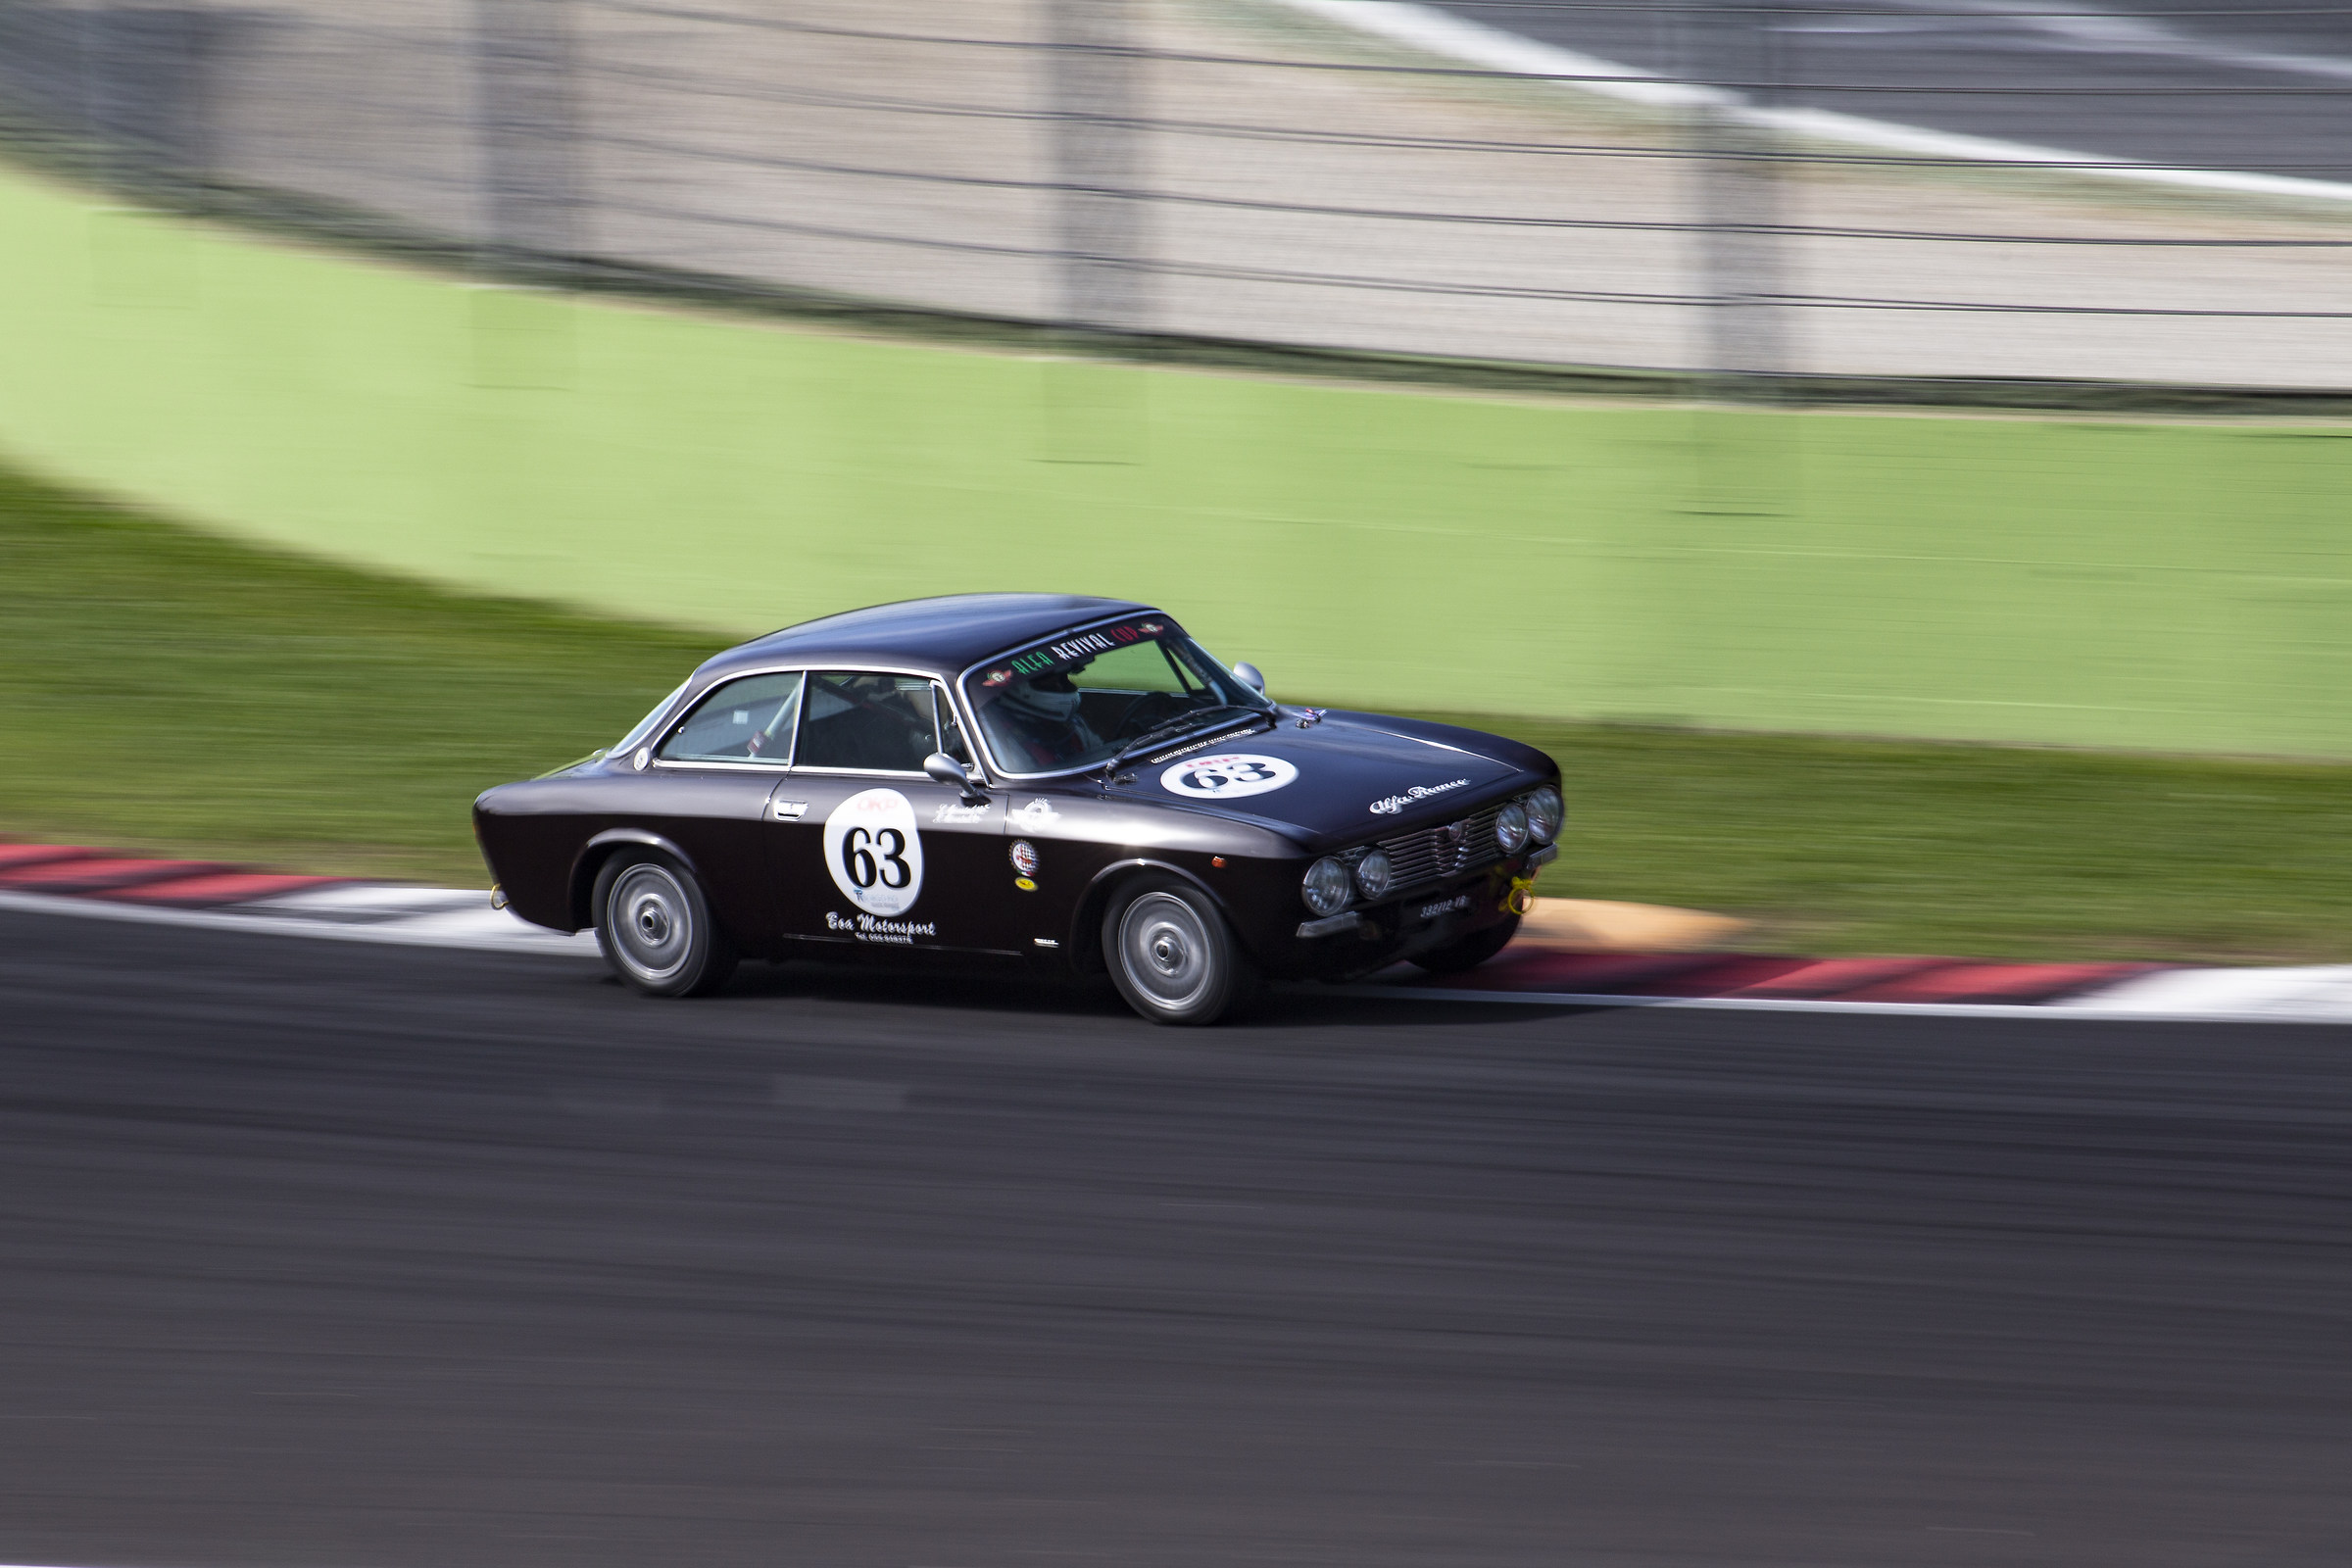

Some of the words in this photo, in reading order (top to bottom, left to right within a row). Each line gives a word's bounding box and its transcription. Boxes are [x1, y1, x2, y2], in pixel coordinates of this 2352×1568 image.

[1011, 651, 1055, 674] ALFA
[1051, 632, 1116, 661] REVIVAL
[1110, 625, 1140, 643] CUP
[1180, 761, 1276, 790] 63
[1369, 795, 1413, 814] Alfa
[1407, 778, 1470, 799] Romeo
[842, 827, 911, 888] 63
[857, 913, 936, 937] Motorsport
